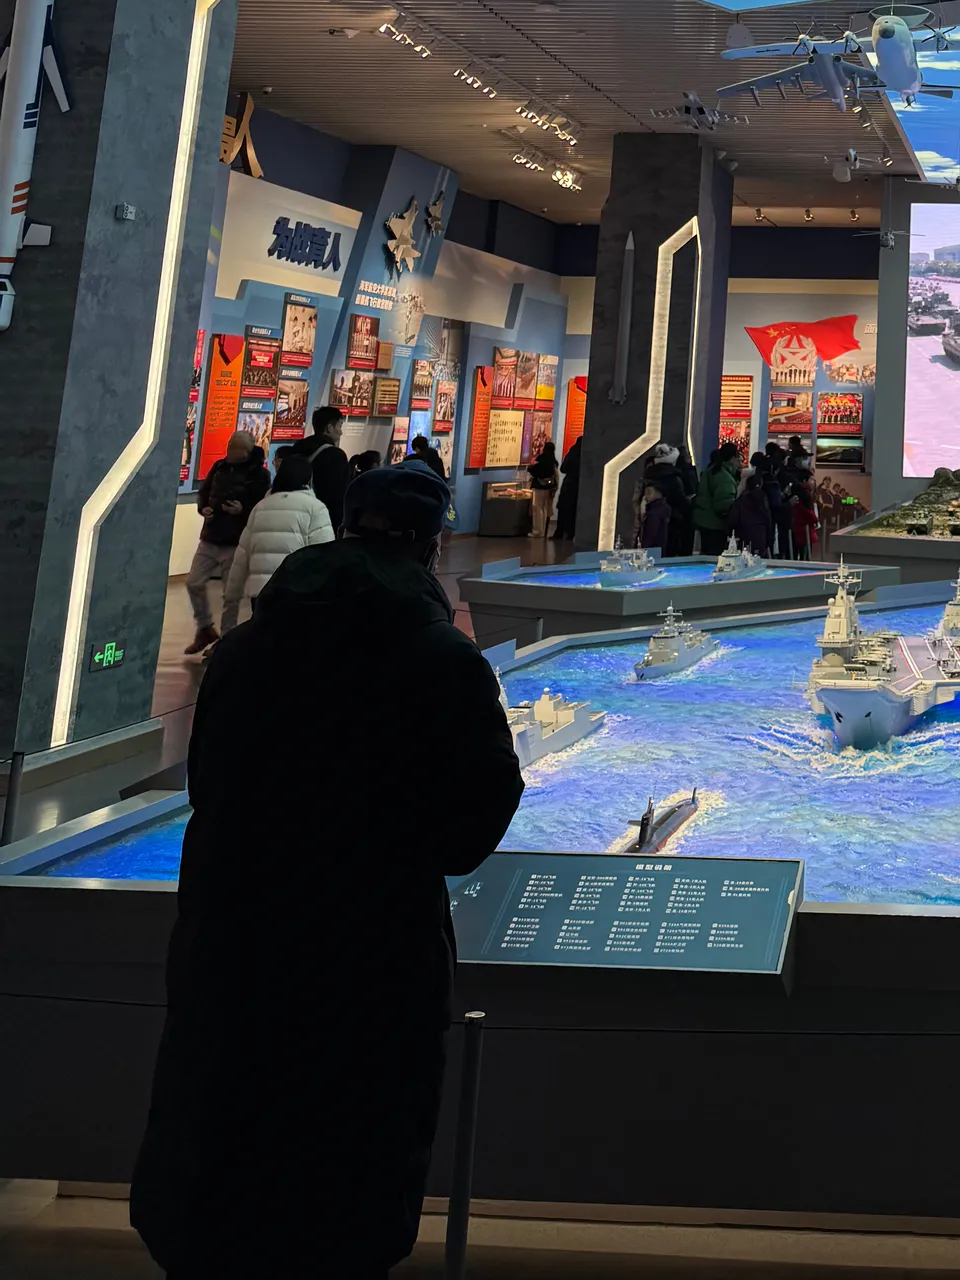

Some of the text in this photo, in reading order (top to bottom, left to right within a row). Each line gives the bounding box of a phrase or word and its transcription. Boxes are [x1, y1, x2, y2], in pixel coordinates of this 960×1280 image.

[267, 216, 342, 272] 为战育人
[635, 863, 673, 871] 模型说明
